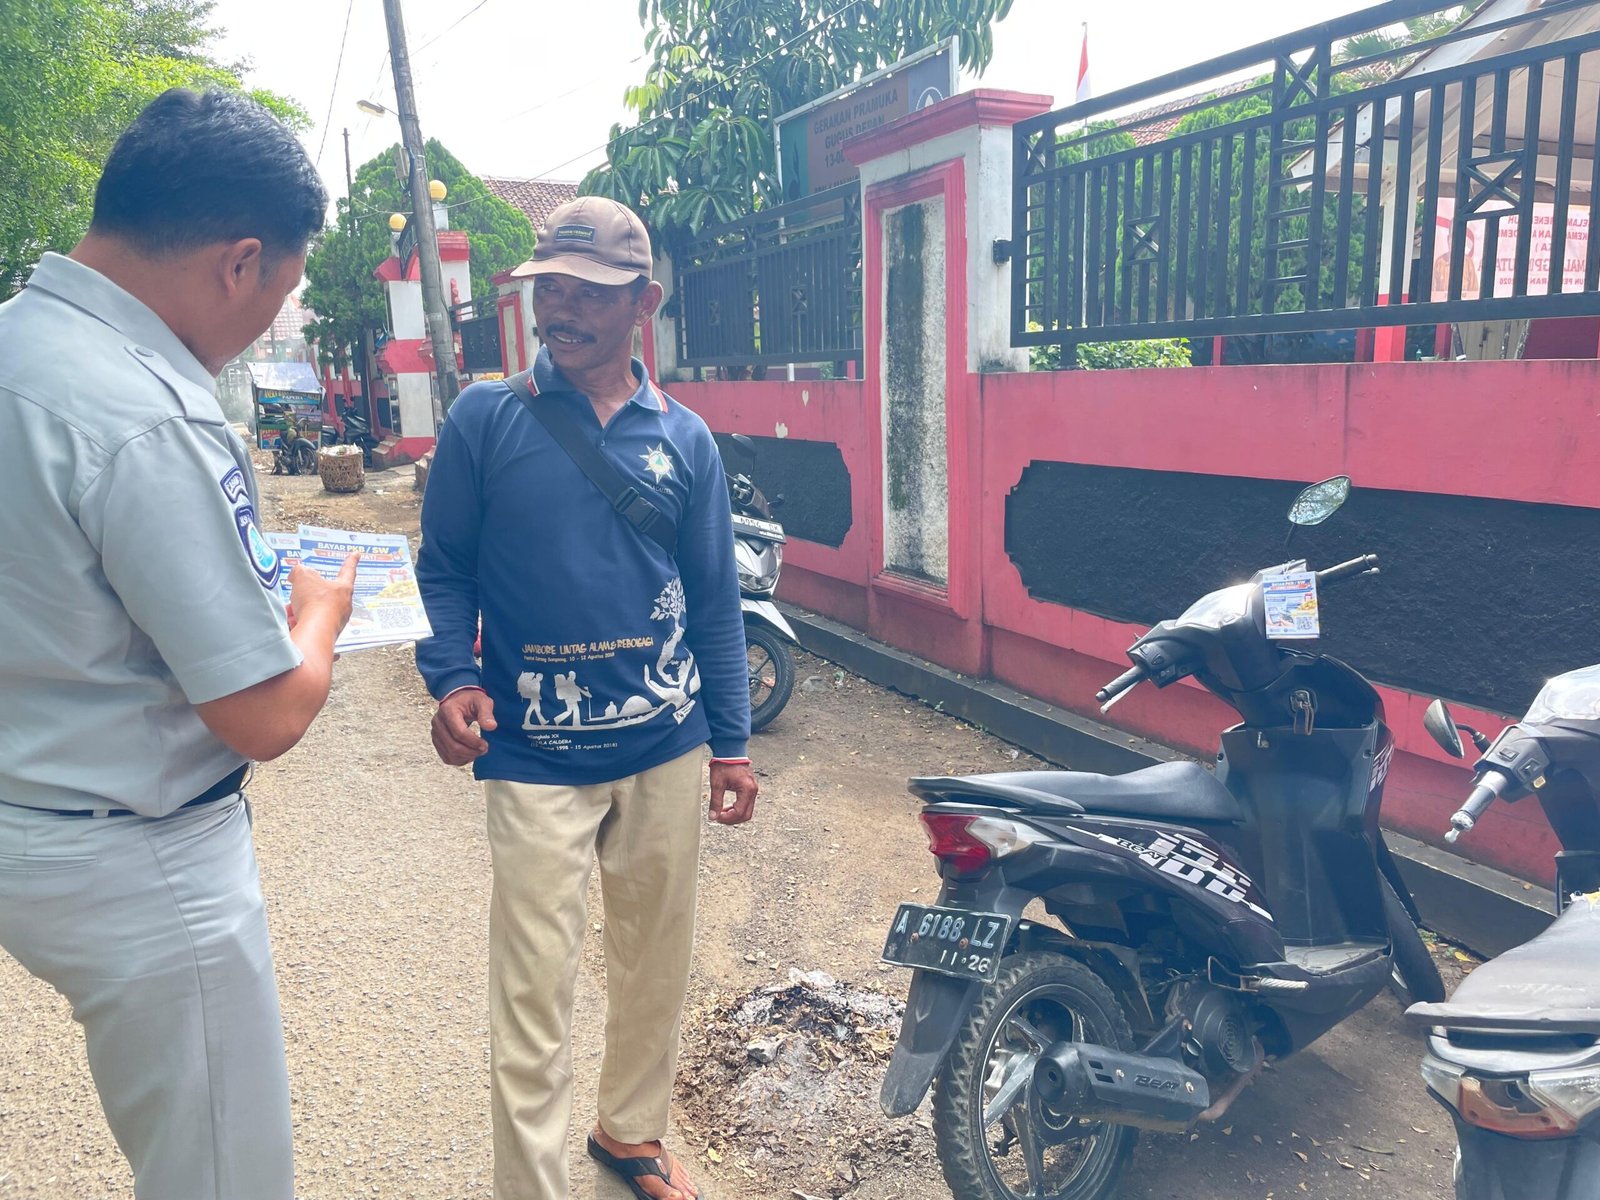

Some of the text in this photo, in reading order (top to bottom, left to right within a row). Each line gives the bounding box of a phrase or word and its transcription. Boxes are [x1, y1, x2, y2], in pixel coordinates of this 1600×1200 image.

[814, 88, 898, 135] GERAKAN PRAMUKA
[318, 542, 345, 551] BAYAR
[347, 545, 365, 553] PKB
[522, 644, 556, 655] JAMBORE
[895, 910, 1000, 949] A 6188 LZ
